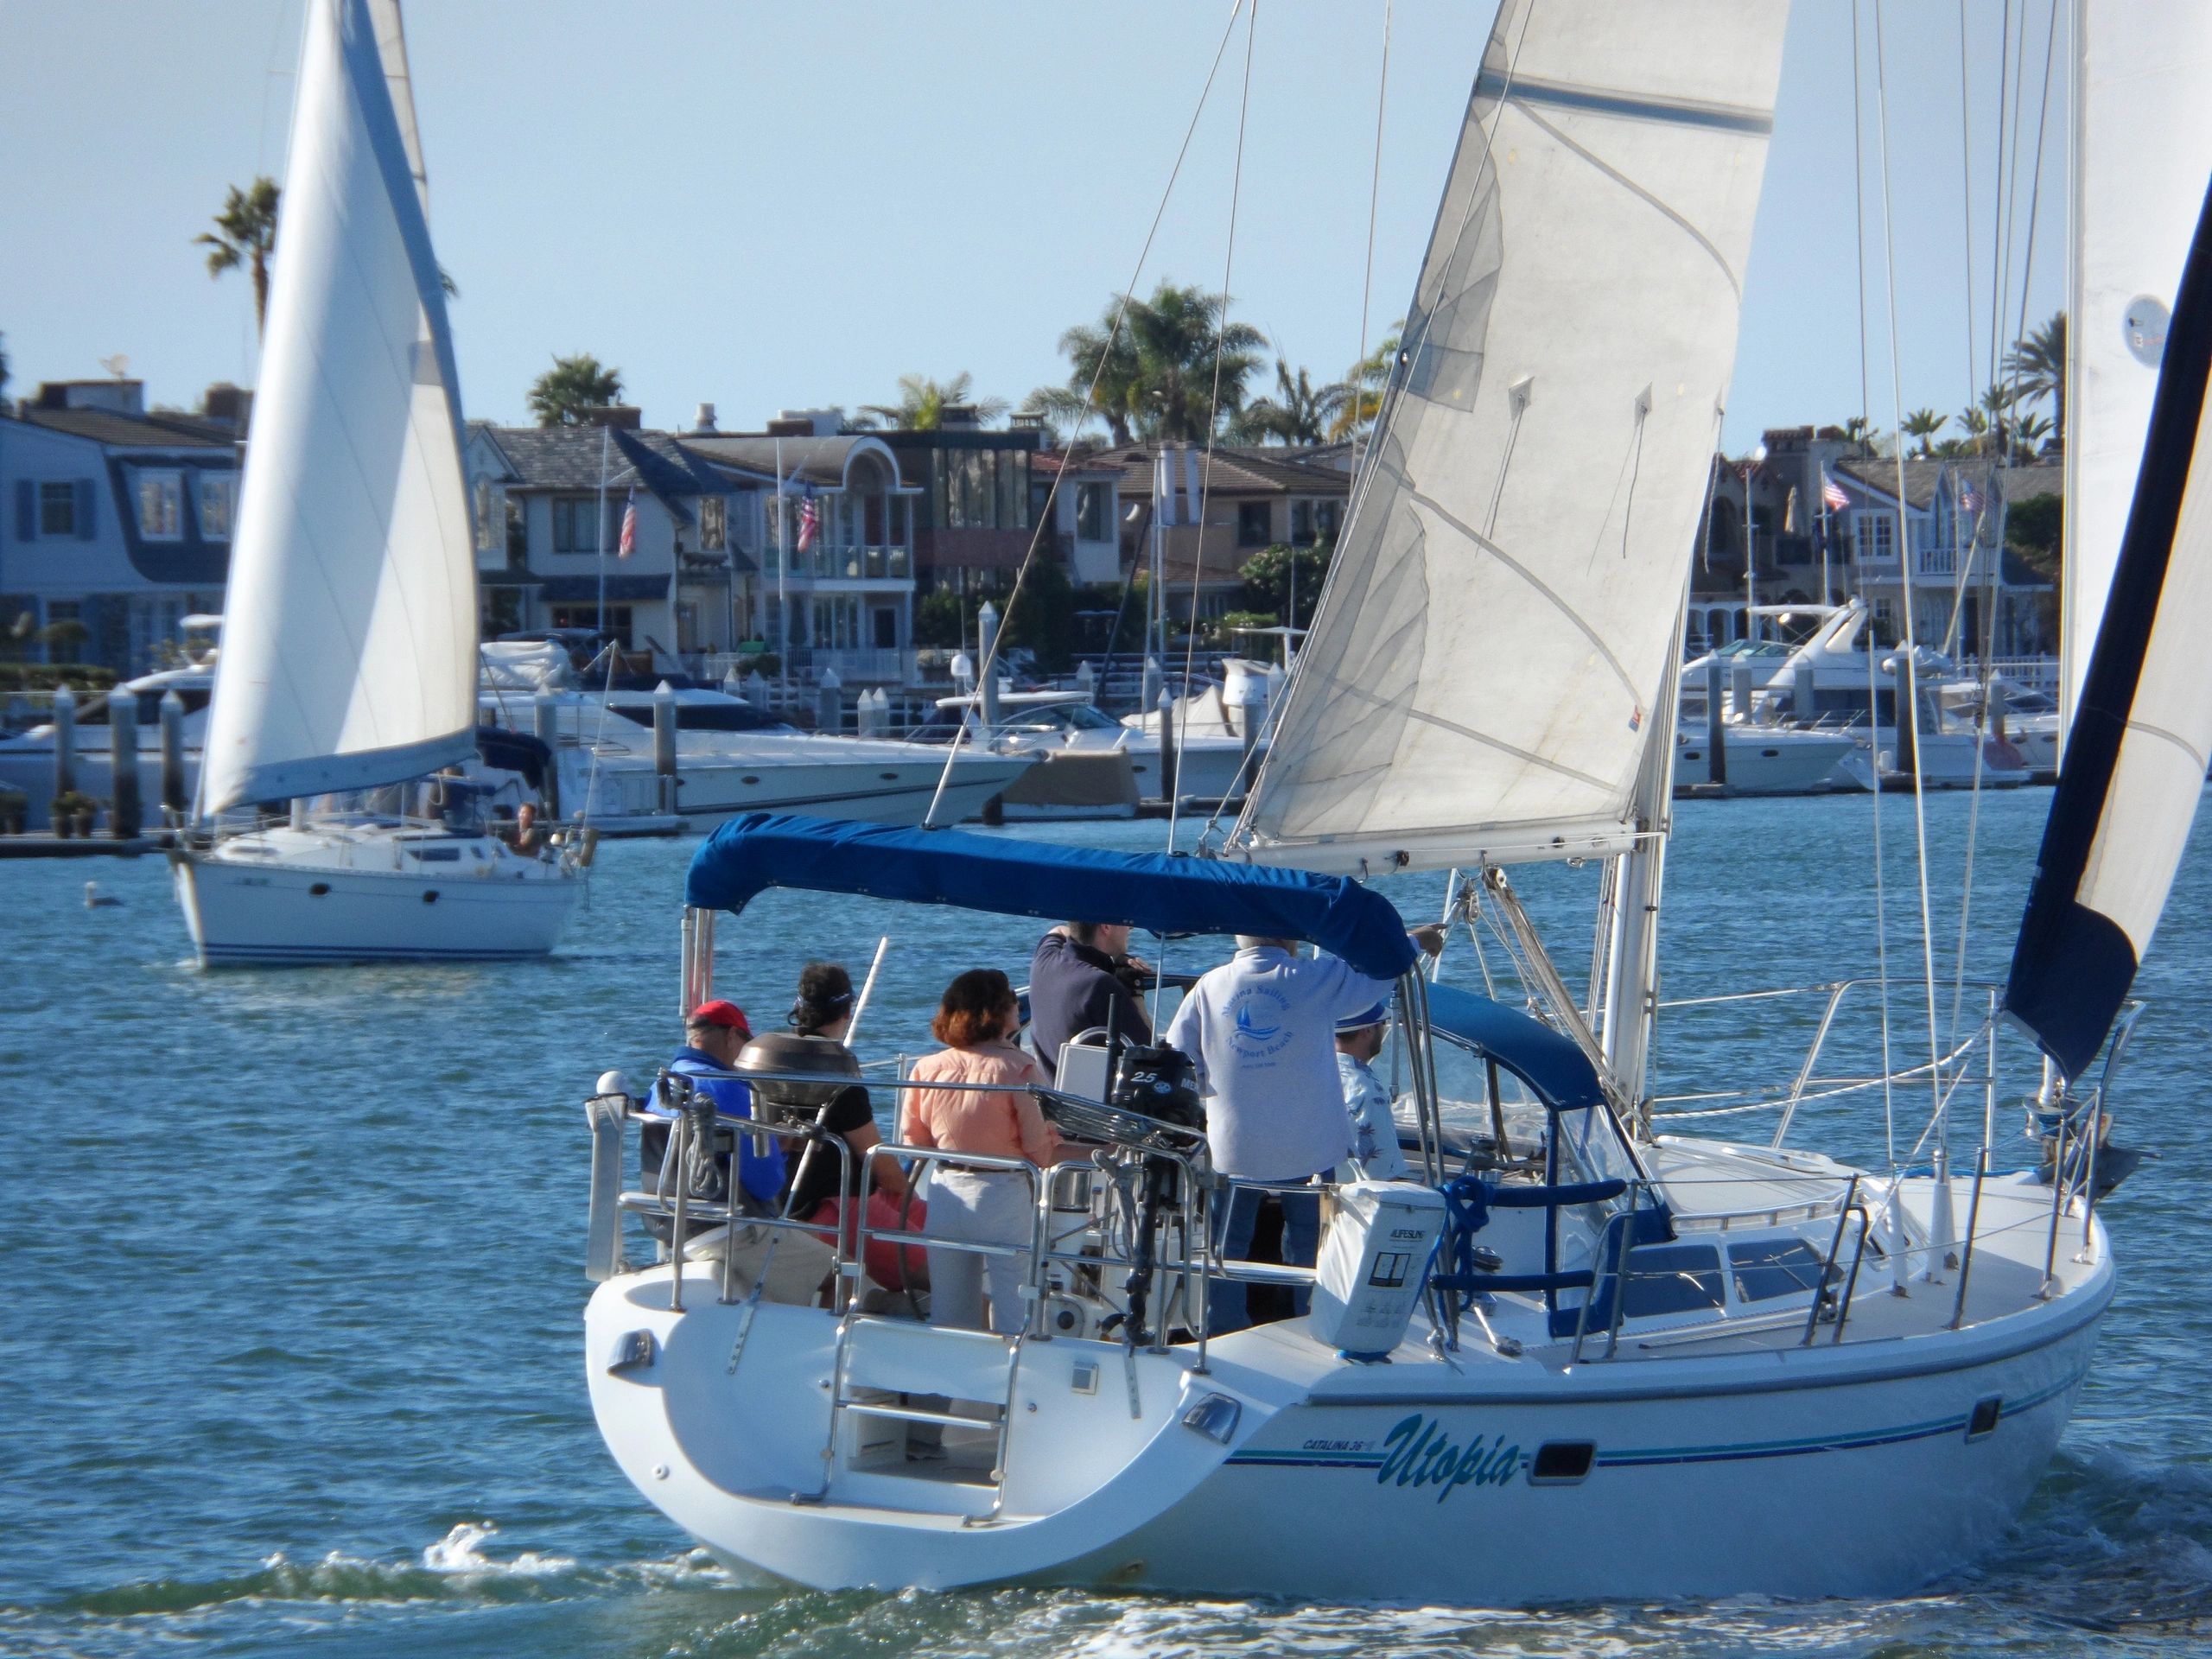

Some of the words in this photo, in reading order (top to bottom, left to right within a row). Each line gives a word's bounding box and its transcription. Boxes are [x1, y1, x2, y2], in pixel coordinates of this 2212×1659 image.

[1256, 984, 1291, 1012] Sailing
[1226, 1035, 1265, 1058] Newport
[1267, 1030, 1294, 1055] Beach
[1302, 1439, 1350, 1451] CATALINA
[1377, 1413, 1521, 1504] Utopia
